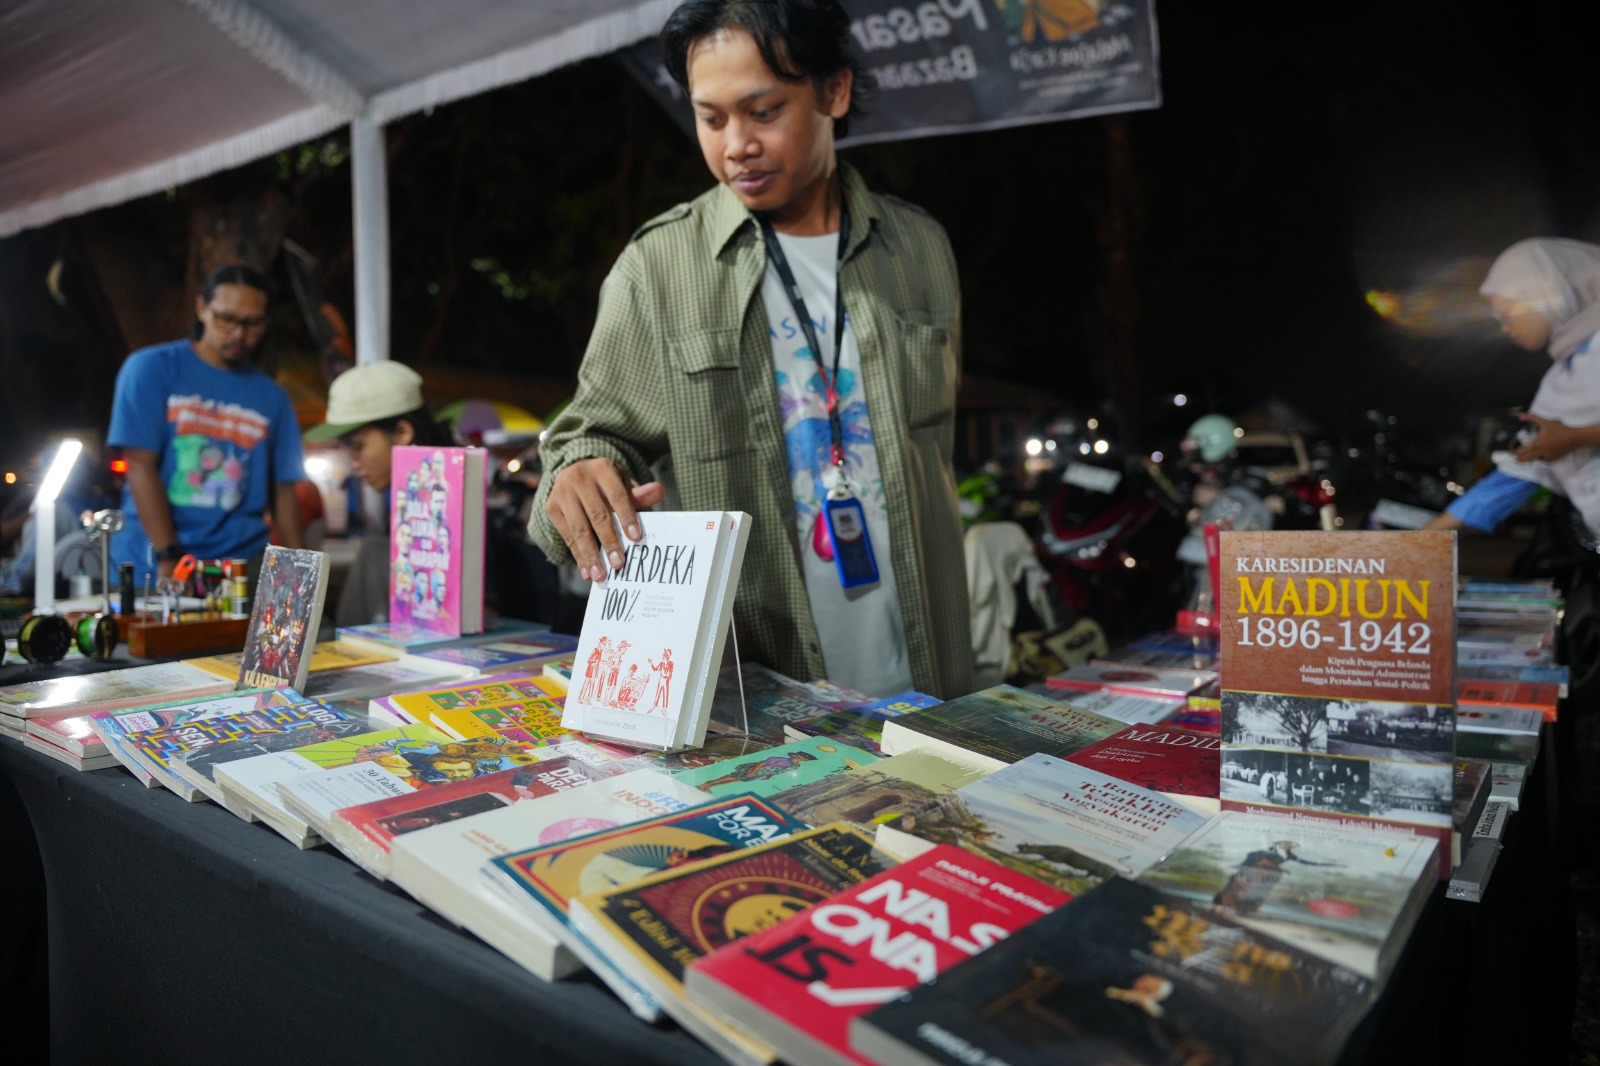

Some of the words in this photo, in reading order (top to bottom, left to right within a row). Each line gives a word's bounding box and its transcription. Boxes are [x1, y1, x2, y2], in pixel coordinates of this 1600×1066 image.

[1236, 557, 1386, 574] KARESIDENAN
[601, 587, 641, 622] 100%
[1236, 576, 1431, 620] MADIUN
[1236, 617, 1431, 655] 1896-1942
[1299, 664, 1324, 674] dalam
[1325, 666, 1375, 677] Modernisasi
[1376, 669, 1431, 680] Administrasi
[1327, 656, 1356, 667] Kiprah
[1357, 657, 1396, 669] Penguasa
[1397, 659, 1431, 670] Belanda
[1301, 674, 1328, 686] hingga
[1329, 676, 1372, 687] Perubahan
[1061, 792, 1159, 833] Yogyakarta
[1079, 781, 1178, 820] Terakhir
[1102, 782, 1185, 815] Banteng
[707, 812, 751, 840] FOR
